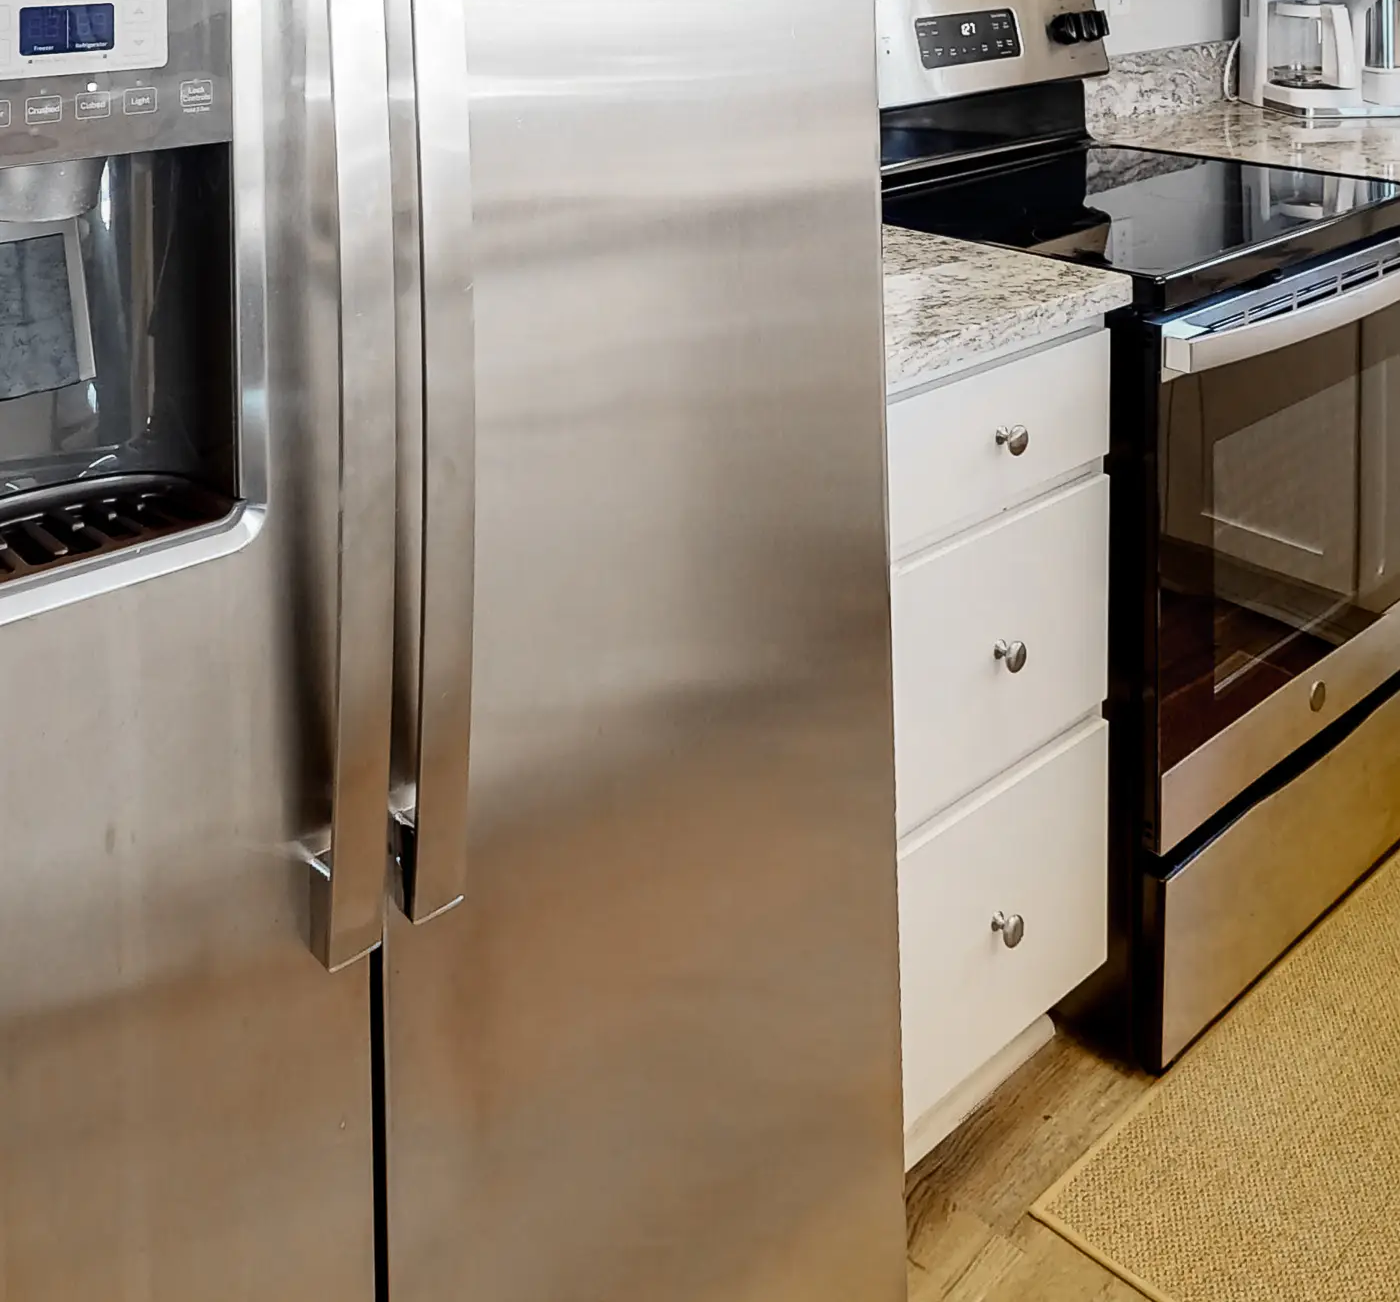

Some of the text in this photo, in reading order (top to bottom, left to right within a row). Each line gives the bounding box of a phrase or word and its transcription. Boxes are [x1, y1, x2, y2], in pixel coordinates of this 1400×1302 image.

[80, 100, 106, 110] Cubed
[130, 97, 151, 107] Light
[28, 105, 61, 115] Crushed
